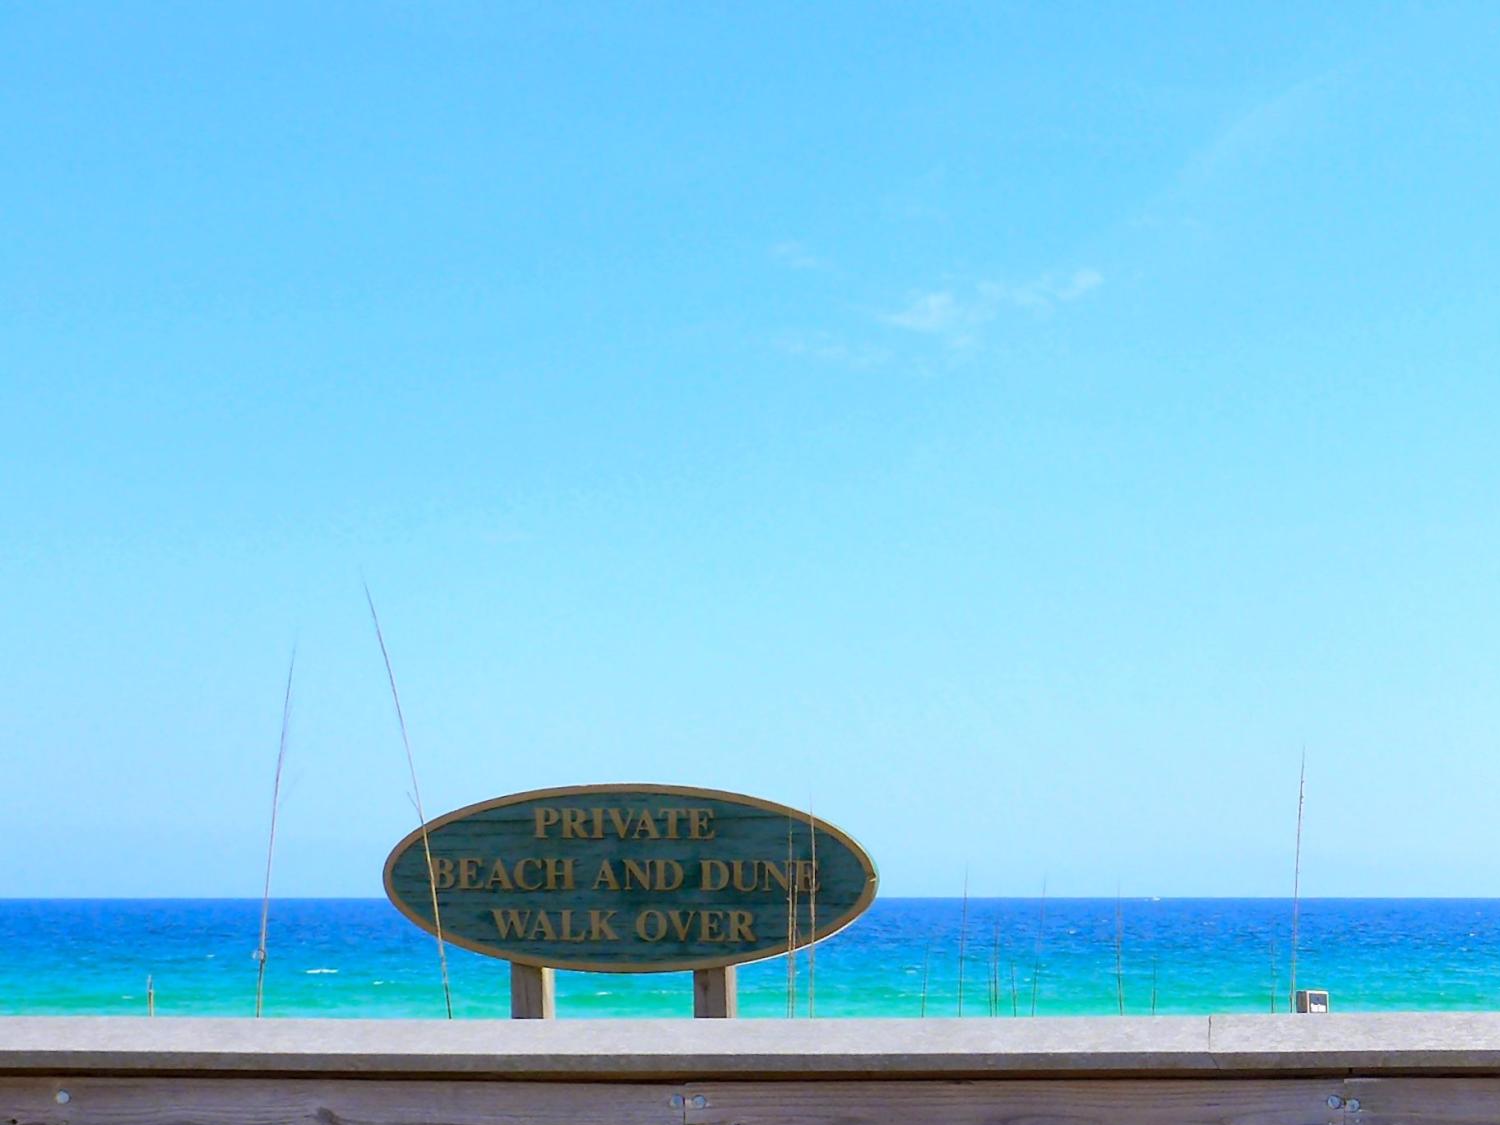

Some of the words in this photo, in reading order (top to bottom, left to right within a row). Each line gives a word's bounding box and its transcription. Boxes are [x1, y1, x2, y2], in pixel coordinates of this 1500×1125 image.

[534, 806, 716, 840] PRIVATE
[431, 857, 578, 891] BEACH
[592, 857, 684, 891] AND
[700, 858, 821, 893] DUNE
[491, 909, 619, 943] WALK
[636, 909, 758, 943] OVER
